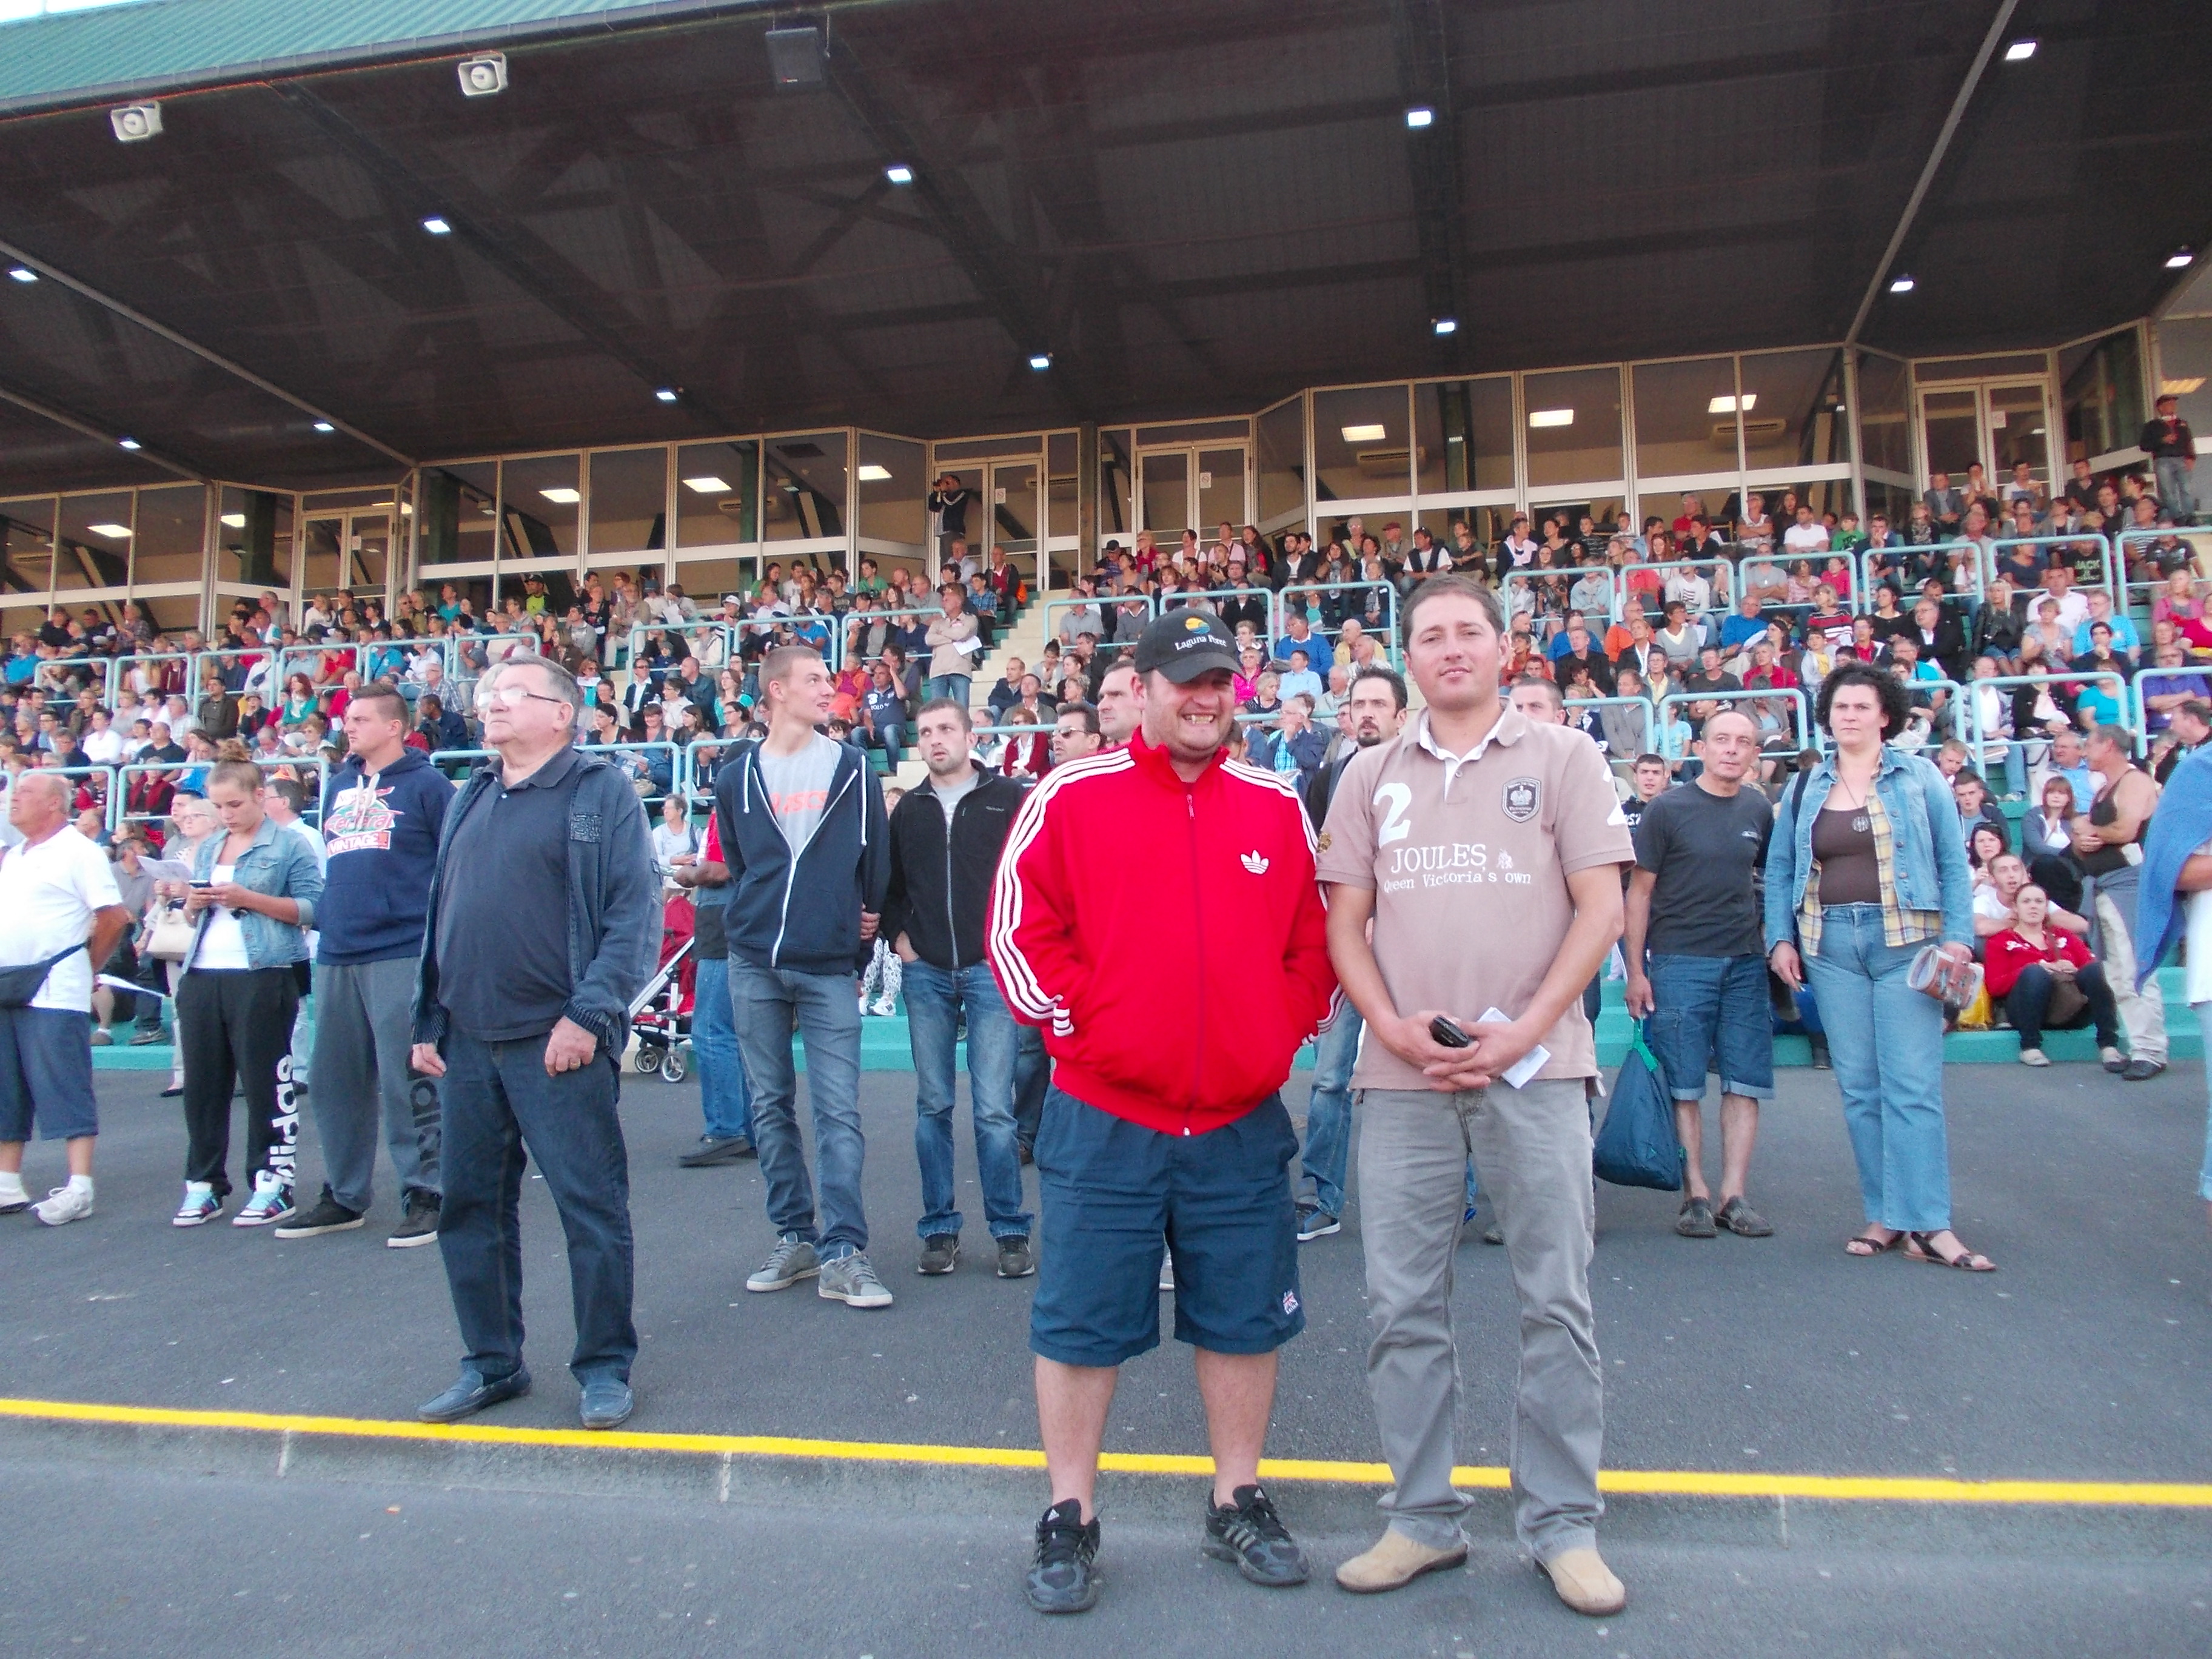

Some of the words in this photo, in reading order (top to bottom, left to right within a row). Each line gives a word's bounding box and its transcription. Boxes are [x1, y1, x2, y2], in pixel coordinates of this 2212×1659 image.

[1175, 635, 1207, 651] Laguna
[1373, 782, 1412, 849] 2
[329, 833, 378, 853] VINTAGE
[1391, 843, 1487, 874] JOULES
